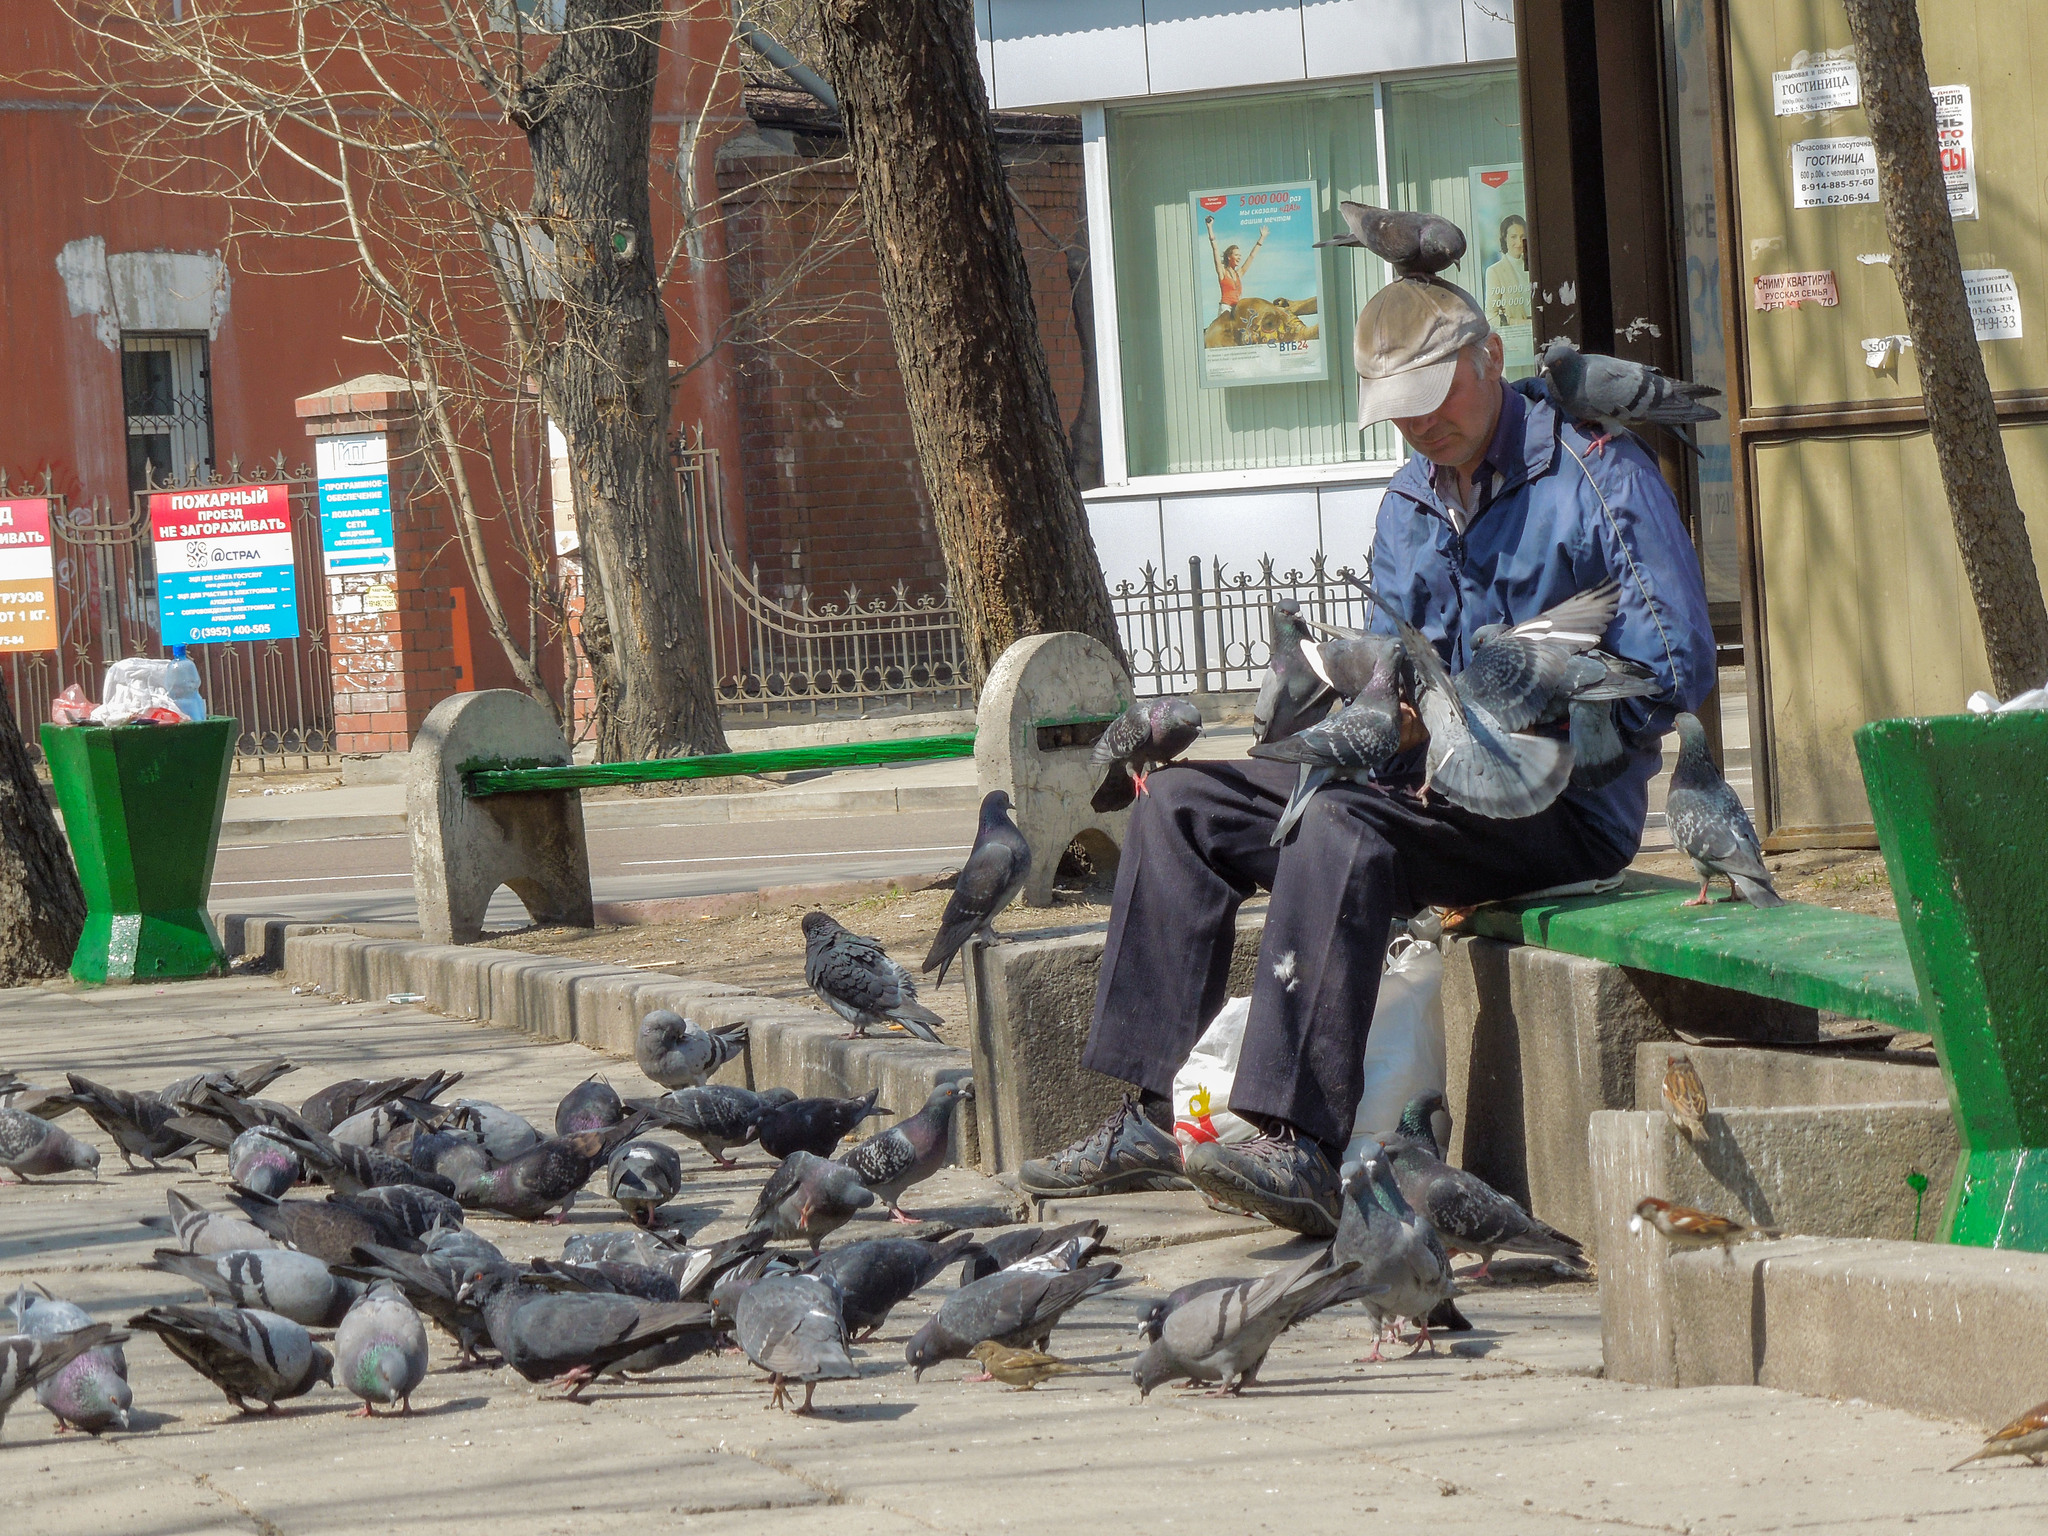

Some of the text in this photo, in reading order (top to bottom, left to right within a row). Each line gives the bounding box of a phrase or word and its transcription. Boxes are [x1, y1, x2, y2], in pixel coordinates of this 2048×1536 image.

[1774, 70, 1809, 82] Почасовая
[1782, 76, 1850, 96] ГОСТИНИЦА
[1796, 143, 1830, 152] Почасовая
[1805, 152, 1865, 167] ГОСТИНИЦА
[1832, 169, 1855, 177] человека
[1861, 167, 1876, 176] сутки
[1802, 178, 1874, 192] 8-914-885-57-60
[1240, 192, 1301, 207] 5 000 000 раз
[1804, 193, 1870, 206] тел. 62-06-94
[1251, 207, 1278, 215] сказали
[1240, 215, 1291, 226] вашим мечтам
[1757, 277, 1785, 290] СНИМУ
[1491, 286, 1506, 296] 700
[1508, 285, 1523, 294] 000
[1765, 288, 1828, 300] РУССКАЯ СЕМЬЯ
[1968, 283, 2012, 296] ИНИЦА
[1492, 298, 1507, 308] 700
[1508, 297, 1524, 306] 000
[1821, 298, 1834, 306] 70
[1279, 341, 1309, 352] ВТБ24
[325, 480, 383, 491] ПРОГРАММНОЕ
[172, 486, 269, 510] ПОЖАРНЫЙ
[326, 491, 383, 502] ОБЕСПЕЧЕНИЕ
[198, 508, 244, 522] ПРОЕЗД
[332, 508, 380, 519] ЛОКАЛЬНЫЕ
[159, 518, 286, 538] НЕ ЗАГОРАЖИВАТЬ
[346, 520, 367, 529] СЕТИ
[214, 573, 233, 581] САЙТА
[18, 610, 26, 621] 1
[30, 610, 50, 621] КГ.
[202, 624, 271, 638] (3952) 400-505
